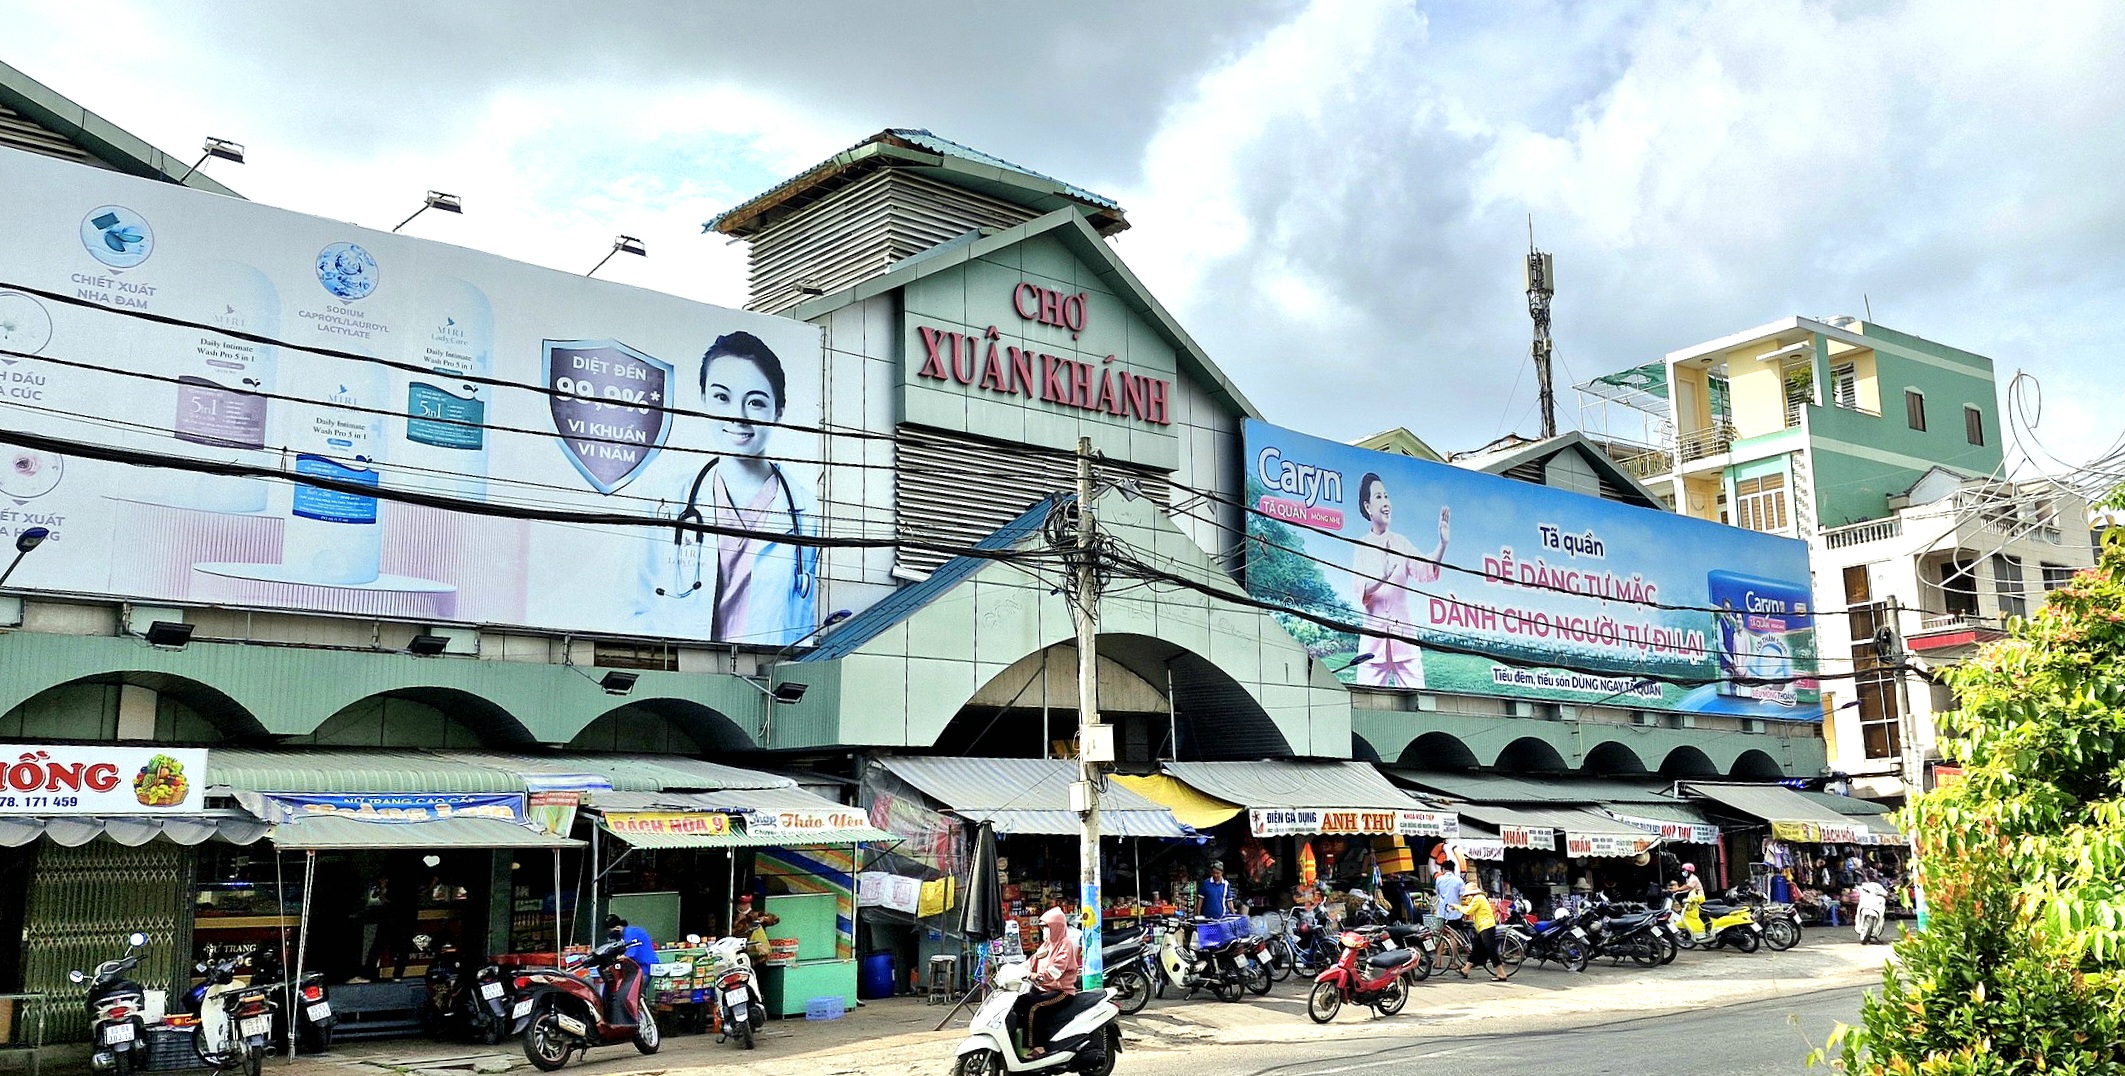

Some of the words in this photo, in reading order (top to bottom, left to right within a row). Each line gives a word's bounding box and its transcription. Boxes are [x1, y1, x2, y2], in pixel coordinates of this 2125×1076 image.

[71, 273, 115, 289] CHIẾT
[118, 282, 157, 297] XUẤT
[77, 288, 110, 303] NHA
[114, 295, 148, 309] ĐAM
[326, 304, 365, 318] SODIUM
[1013, 281, 1088, 341] CHỢ
[298, 310, 390, 333] CAPROYL/LAUROYL
[317, 323, 371, 339] LACTYLATE
[197, 347, 218, 357] Wash
[219, 350, 233, 359] Pro
[200, 338, 221, 348] Daily
[223, 342, 254, 353] Intimate
[426, 347, 444, 357] Daily
[445, 351, 472, 361] Intimate
[423, 355, 442, 365] Wash
[443, 359, 455, 367] Pro
[461, 362, 468, 370] in
[572, 355, 609, 375] DIỆT
[613, 362, 648, 381] ĐẾN
[917, 325, 1035, 399] XUÂN
[1040, 354, 1172, 426] KHÁNH
[10, 386, 43, 401] CÚC
[313, 426, 333, 435] Wash
[334, 429, 347, 437] Pro
[316, 417, 335, 428] Daily
[337, 420, 366, 430] Intimate
[568, 419, 586, 434] VI
[578, 442, 595, 456] VI
[1258, 446, 1343, 509] Caryn
[1263, 499, 1277, 515] TÃ
[23, 512, 66, 526] XUẤT
[14, 528, 60, 541] HG
[1540, 526, 1559, 549] Tã
[1563, 532, 1604, 557] quần
[1484, 550, 1515, 584] DỄ
[1520, 560, 1580, 593] DÀNG
[1584, 572, 1610, 606] TỰ
[1615, 578, 1656, 611] MẶC
[1745, 590, 1780, 620] Caryn
[1429, 594, 1497, 631] DÀNH
[1502, 608, 1550, 638] CHO
[1556, 615, 1620, 647] NGƯỜI
[1623, 624, 1649, 657] TỰ
[1652, 629, 1673, 653] ĐI
[1674, 632, 1705, 661] LẠI
[1493, 668, 1513, 681] Tiểu
[1514, 669, 1536, 686] đêm,
[1537, 672, 1554, 686] tiểu
[1555, 676, 1570, 688] són
[1572, 674, 1599, 690] DÙNG
[1600, 679, 1624, 693] NGAY
[25, 796, 47, 807] 171
[53, 796, 78, 807] 459
[712, 815, 724, 833] 9
[748, 813, 777, 825] Shop
[780, 813, 825, 829] Thảo
[829, 813, 864, 829] Yên
[1267, 811, 1284, 826] ĐIỆN
[1321, 812, 1358, 831] ANH
[1361, 810, 1397, 832] THƯ
